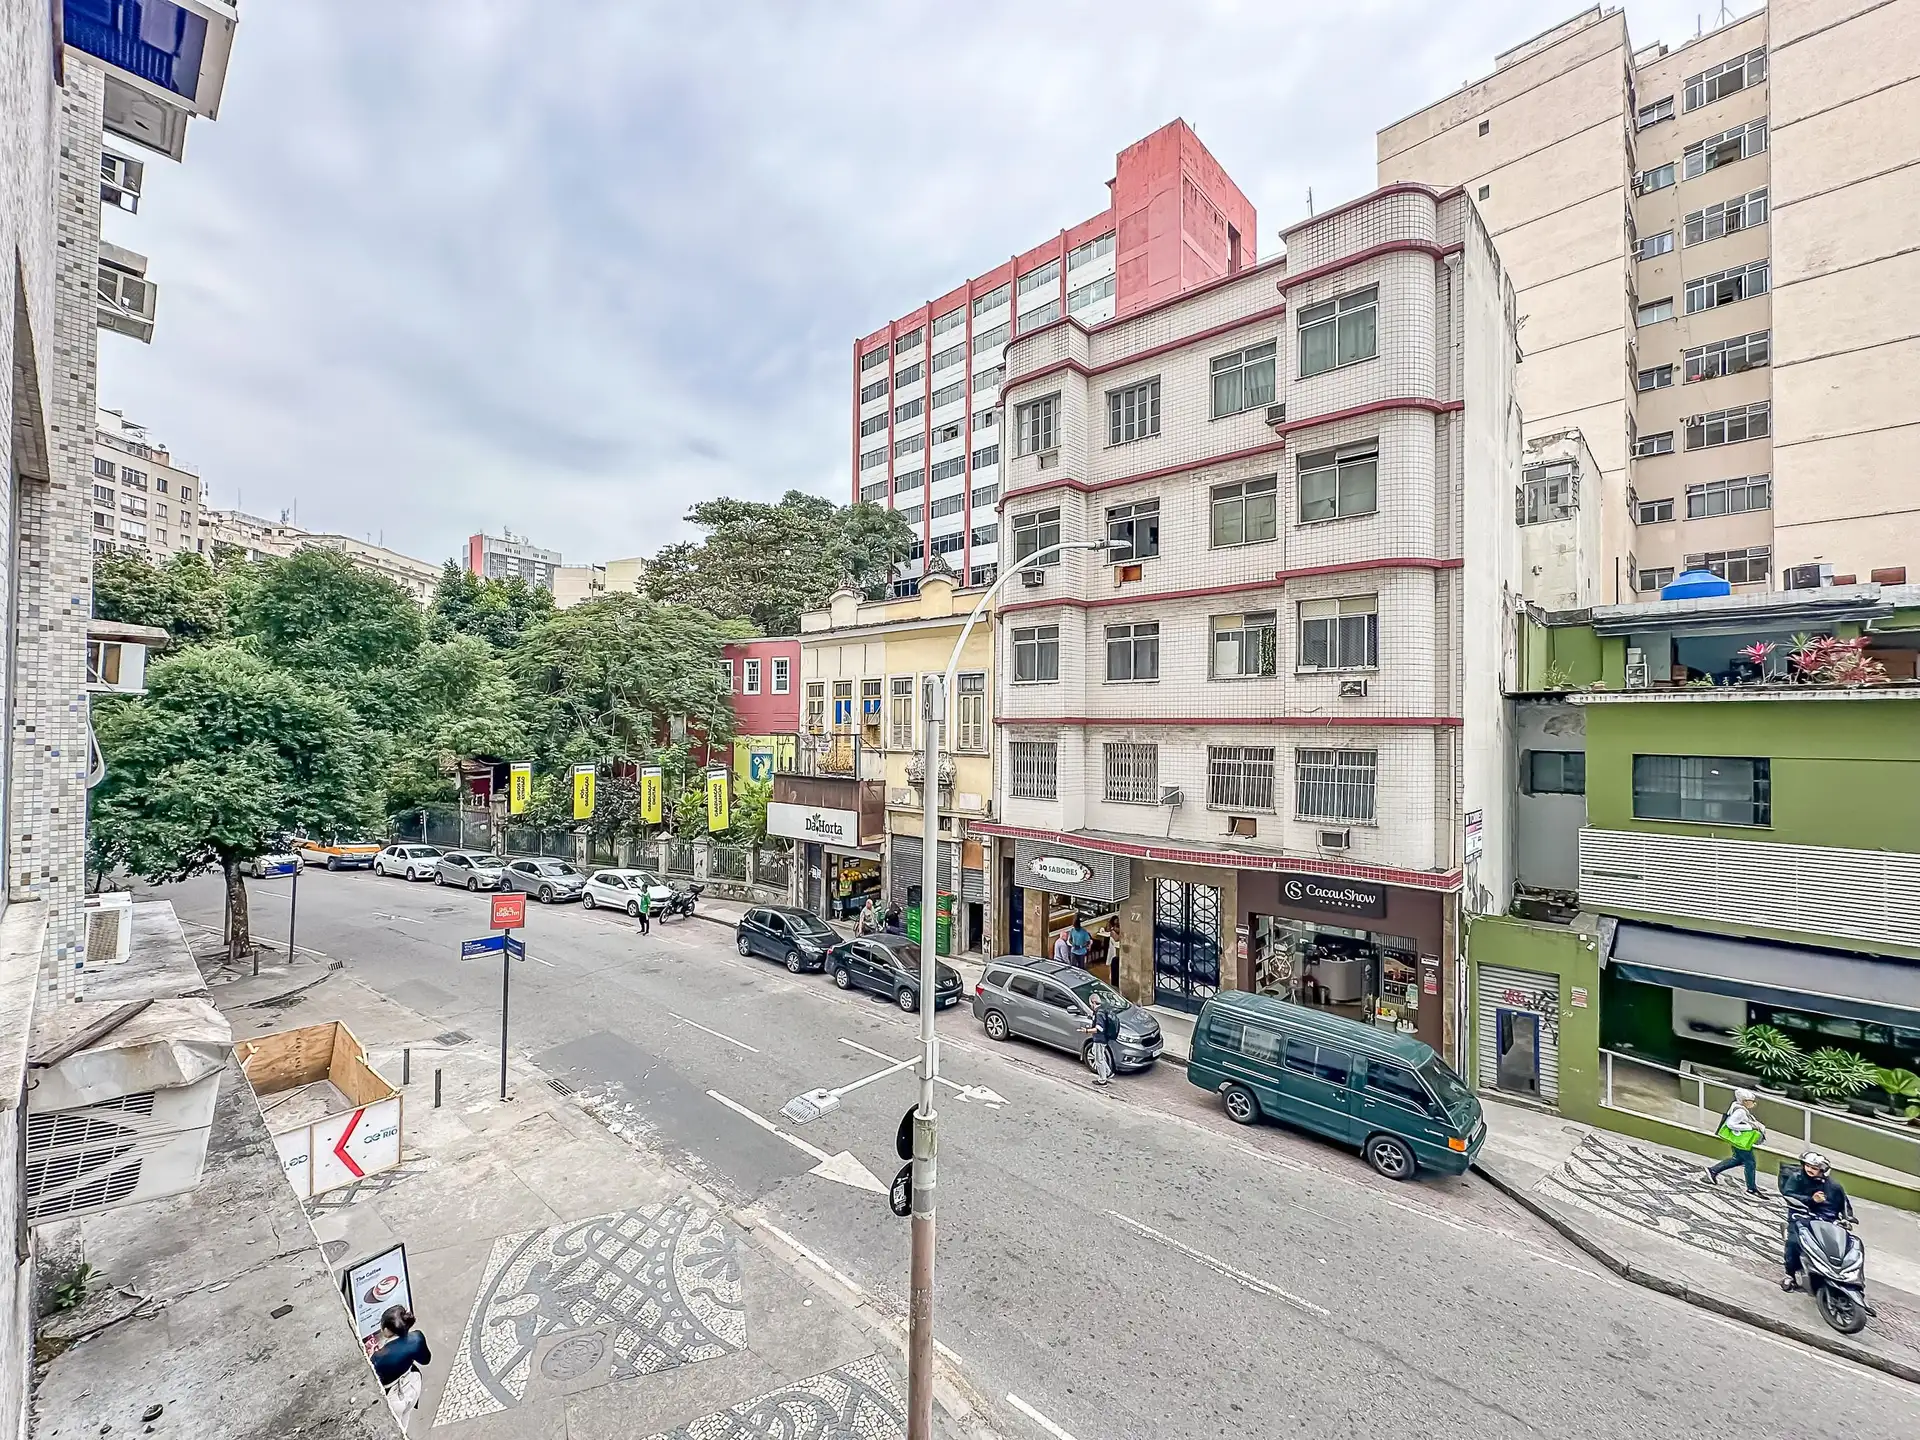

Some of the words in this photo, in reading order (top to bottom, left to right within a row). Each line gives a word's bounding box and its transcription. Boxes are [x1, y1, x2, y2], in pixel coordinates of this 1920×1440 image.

[805, 818, 816, 831] Da
[819, 820, 843, 835] Horta
[1048, 866, 1078, 876] SABORES
[1306, 884, 1376, 904] CacauShow
[382, 1128, 398, 1139] RIO
[365, 1267, 382, 1277] Coffee
